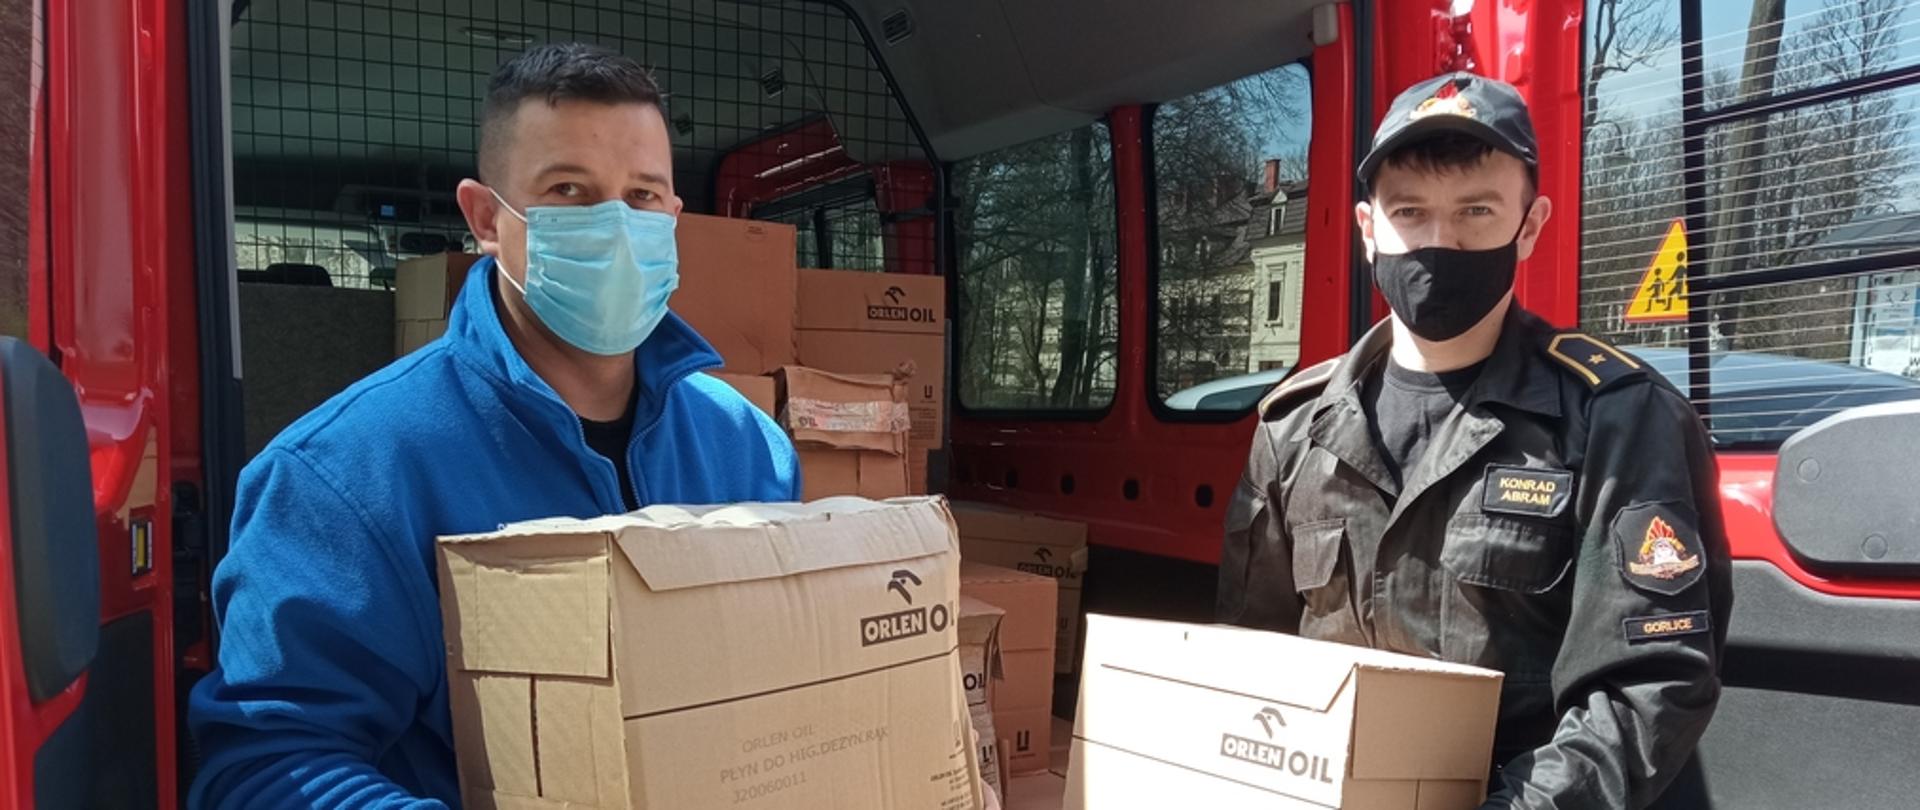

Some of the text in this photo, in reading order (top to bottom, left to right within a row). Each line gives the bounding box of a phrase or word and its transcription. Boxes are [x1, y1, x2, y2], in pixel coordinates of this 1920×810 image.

[910, 307, 936, 323] OIL
[1499, 477, 1556, 492] KONRAD
[1501, 489, 1551, 505] ABRAM
[862, 608, 926, 645] ORLEN
[1643, 617, 1693, 634] GORLICE
[741, 723, 817, 754] ORLEN OIL
[763, 754, 786, 772] DO
[1221, 734, 1333, 784] ORLEN OIL
[734, 770, 808, 805] J20060011
